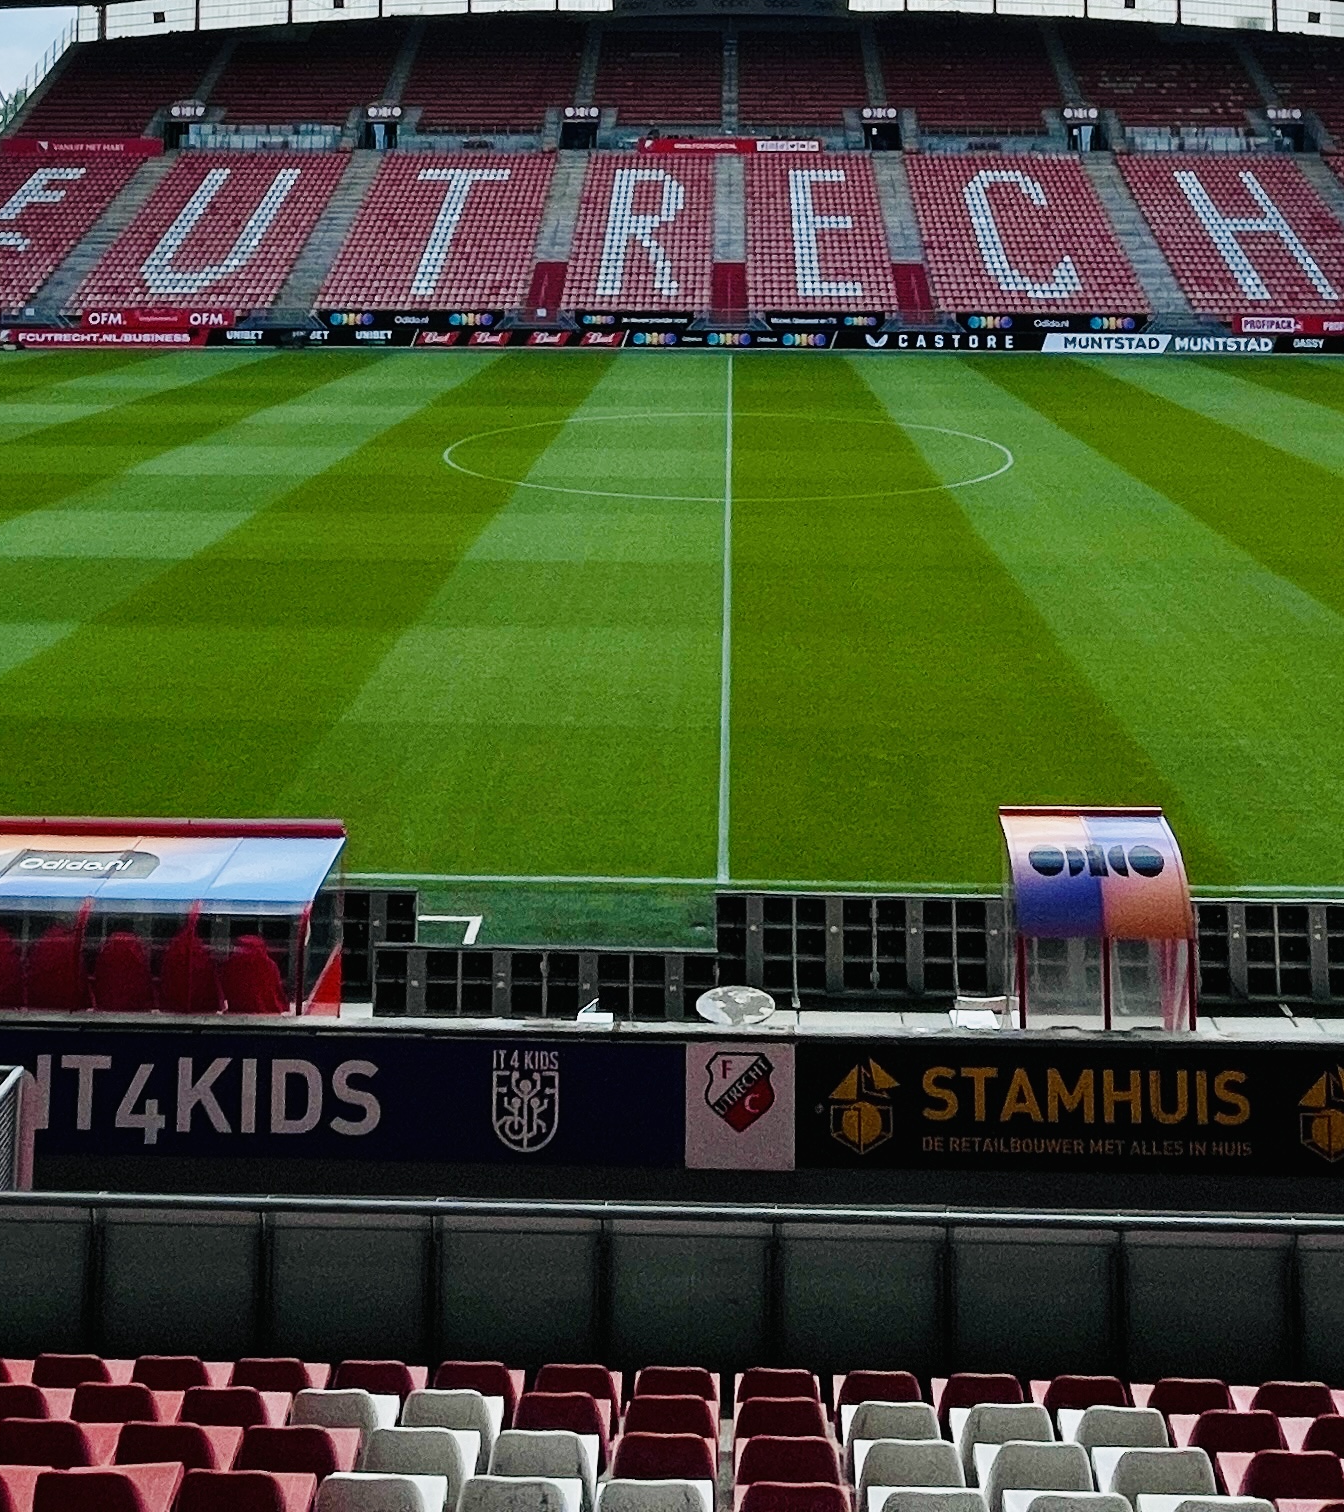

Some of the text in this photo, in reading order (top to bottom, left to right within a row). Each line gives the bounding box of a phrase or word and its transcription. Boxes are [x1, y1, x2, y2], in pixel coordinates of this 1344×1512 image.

[88, 312, 127, 325] OFM.
[189, 312, 229, 325] OFM.
[1034, 318, 1070, 328] Odido.nl
[1243, 319, 1293, 330] PROFIPACK
[18, 332, 191, 343] FCUTRECHT.NL/BUSINESS
[226, 330, 264, 340] UNIBET
[898, 334, 1015, 348] CASTORE
[1063, 337, 1161, 350] MUNTSTAD
[1175, 337, 1273, 351] MUNTSTAD
[1293, 339, 1325, 348] DASSY
[19, 856, 134, 872] Odido.nl
[492, 1050, 560, 1070] IT 4 KIDS
[33, 1054, 382, 1145] IT4KIDS
[921, 1066, 1251, 1125] STAMHUIS
[922, 1136, 1253, 1157] DE RETAILBOUWER MET ALLES IN HUIS
